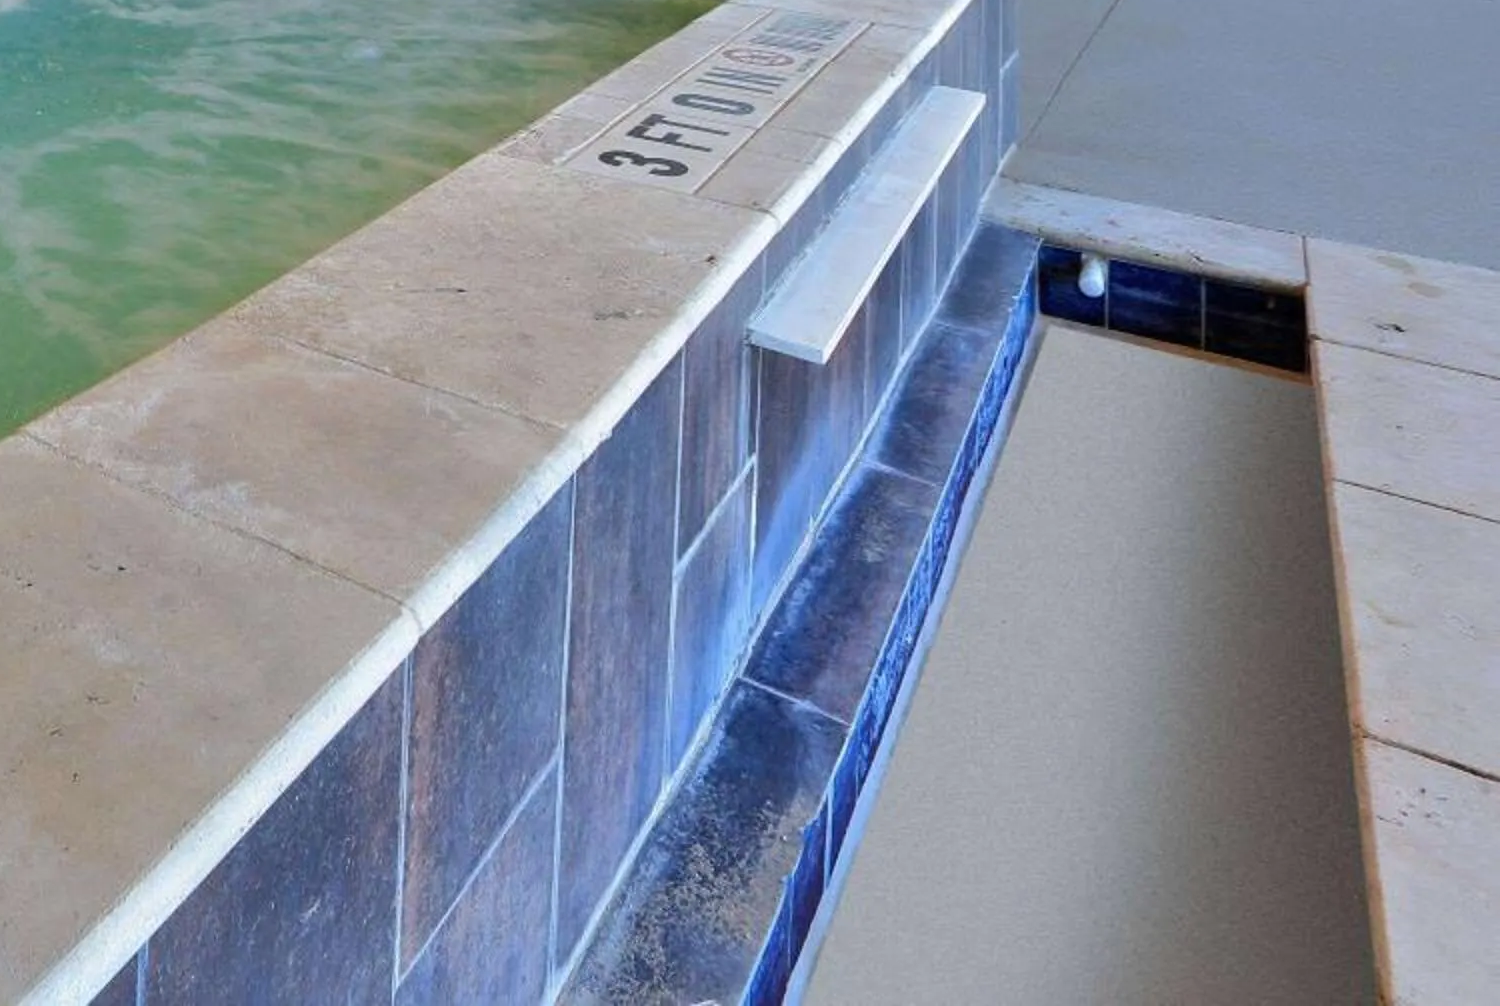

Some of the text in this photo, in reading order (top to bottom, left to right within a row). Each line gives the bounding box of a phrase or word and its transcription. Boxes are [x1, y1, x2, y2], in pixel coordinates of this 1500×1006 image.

[695, 65, 788, 94] IN
[625, 113, 731, 152] FT
[597, 150, 689, 177] 3
